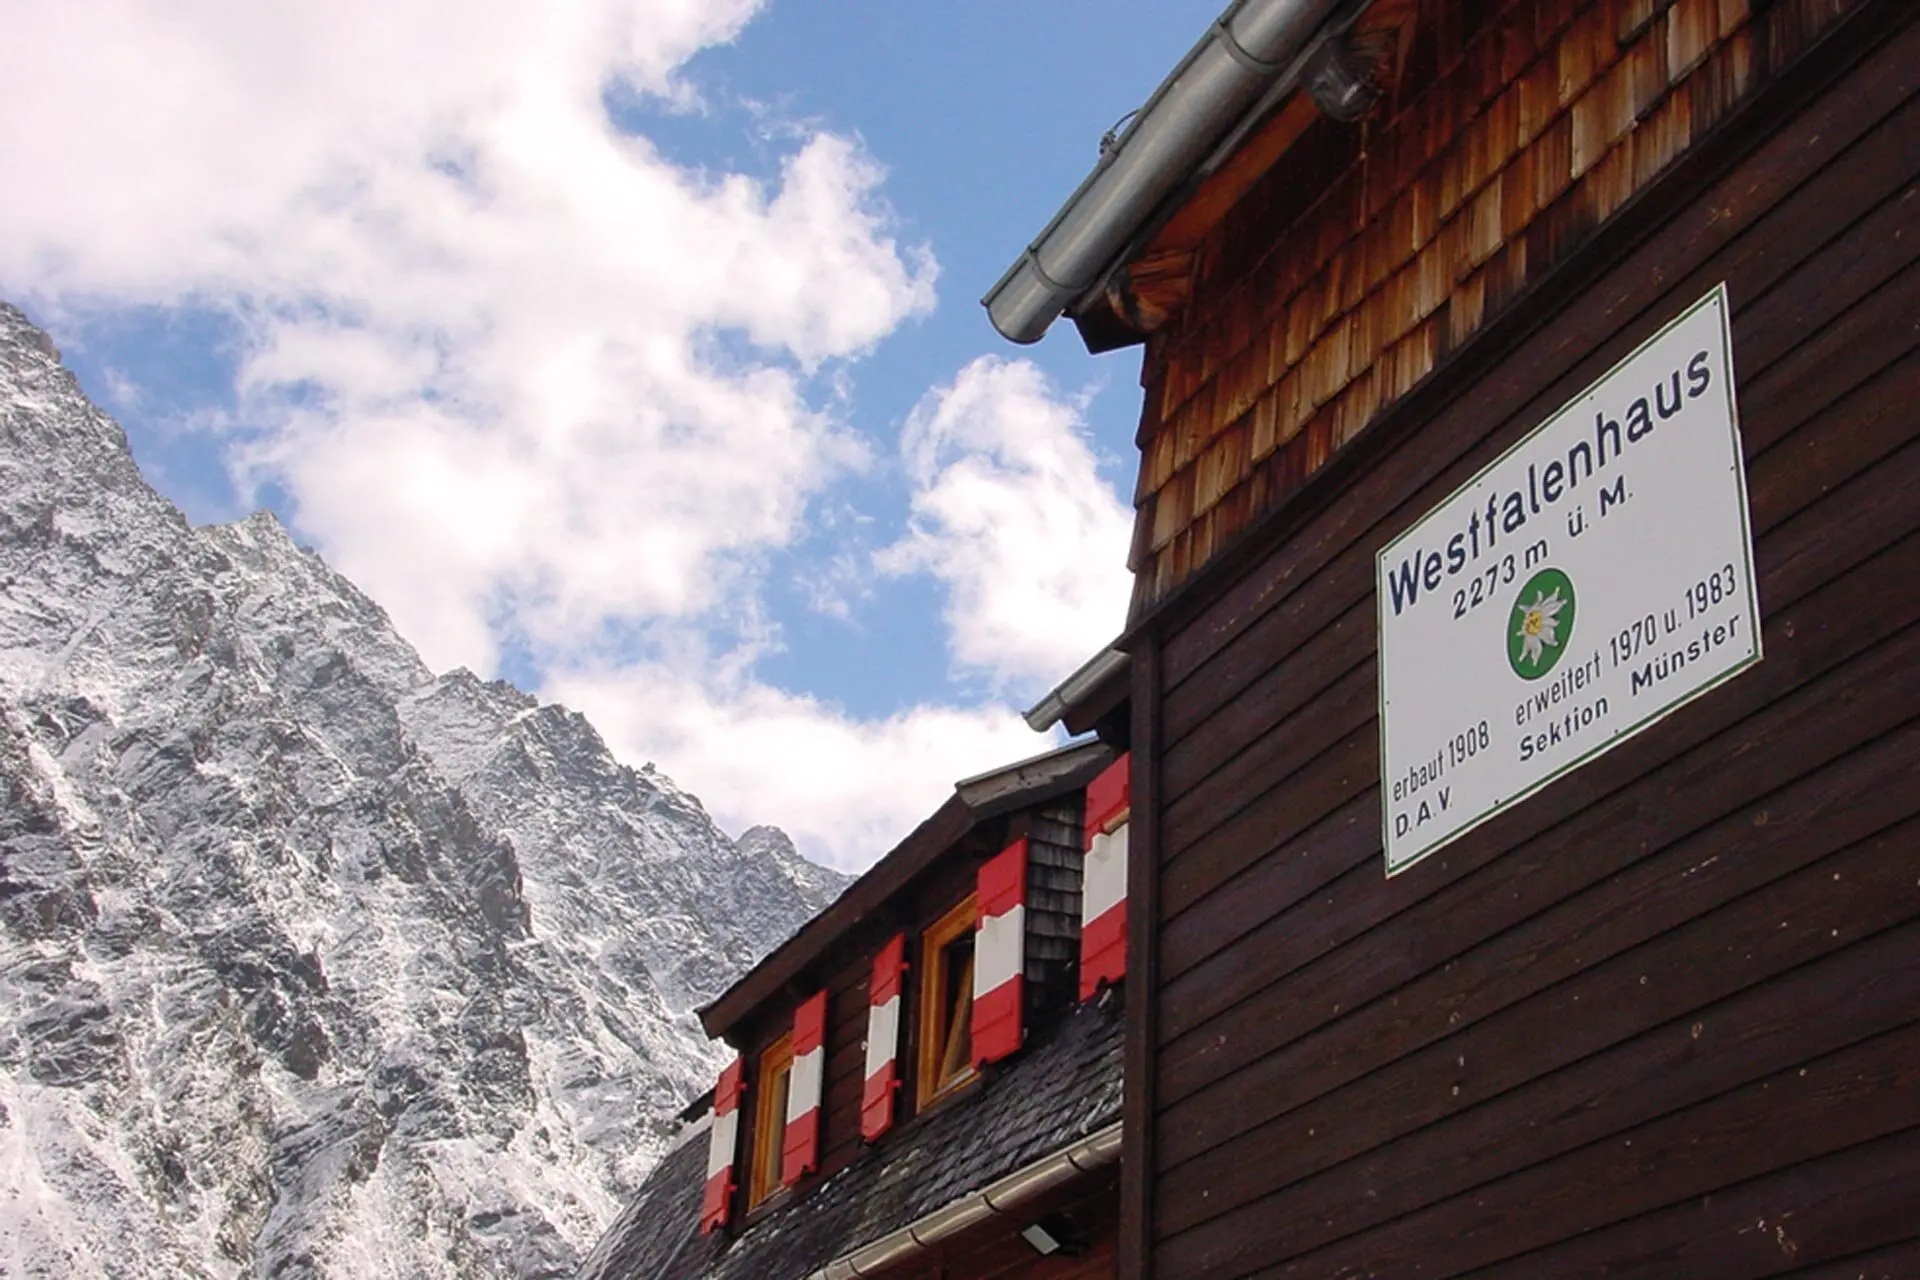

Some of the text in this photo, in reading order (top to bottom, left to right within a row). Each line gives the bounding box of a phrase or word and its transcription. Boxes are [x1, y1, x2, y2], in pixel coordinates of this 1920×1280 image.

[1388, 349, 1711, 616] Westfalenhaus
[1453, 474, 1634, 620] 2273 m ü. M.
[1392, 562, 1737, 802] erbaut 1908 erweitert 1970 u. 1983
[1518, 695, 1609, 763] Sektion
[1630, 614, 1741, 697] Münster
